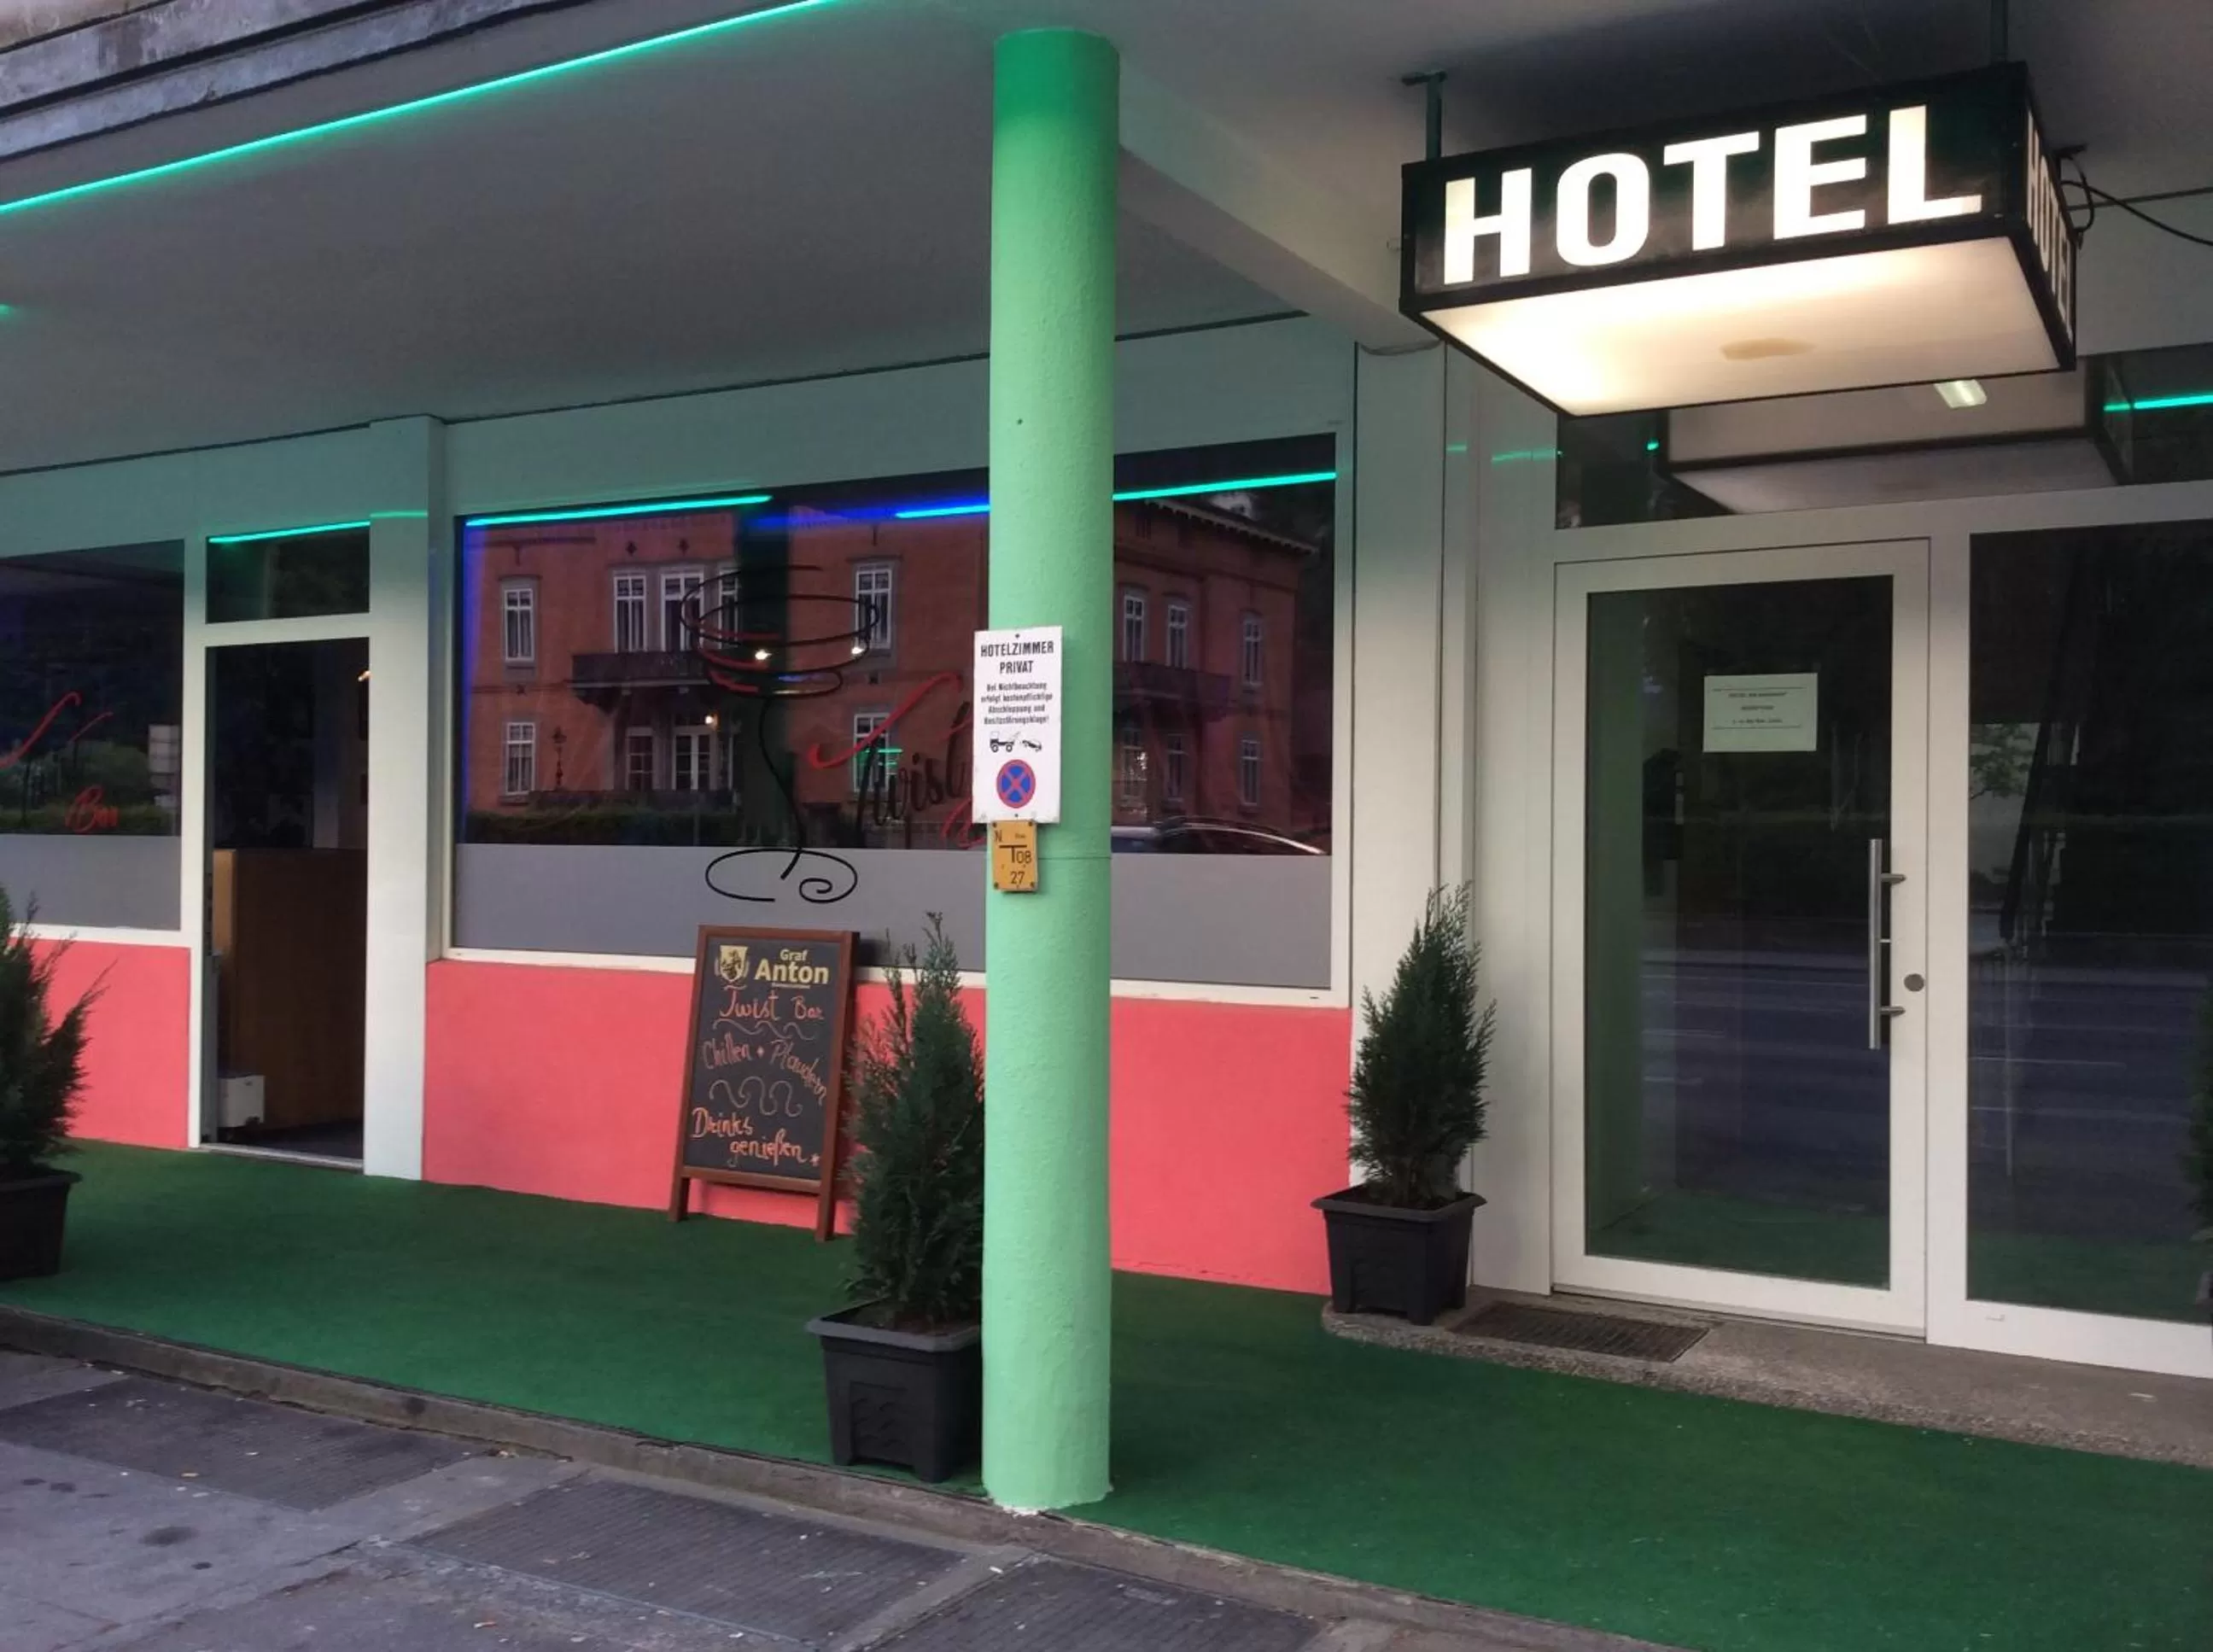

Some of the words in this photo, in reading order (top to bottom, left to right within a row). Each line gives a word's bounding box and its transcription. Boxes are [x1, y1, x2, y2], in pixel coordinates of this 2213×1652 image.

[1443, 104, 1983, 285] HOTEL
[2027, 109, 2073, 344] HOTEL
[980, 641, 1054, 657] HOTELZIMMER
[1000, 661, 1034, 674] PRIVAT
[780, 949, 809, 961] Graf
[754, 958, 829, 984] Anton
[720, 984, 780, 1020] Twist
[791, 995, 824, 1019] Bar
[703, 1031, 752, 1069] Chillen
[692, 1107, 753, 1138] Drinks
